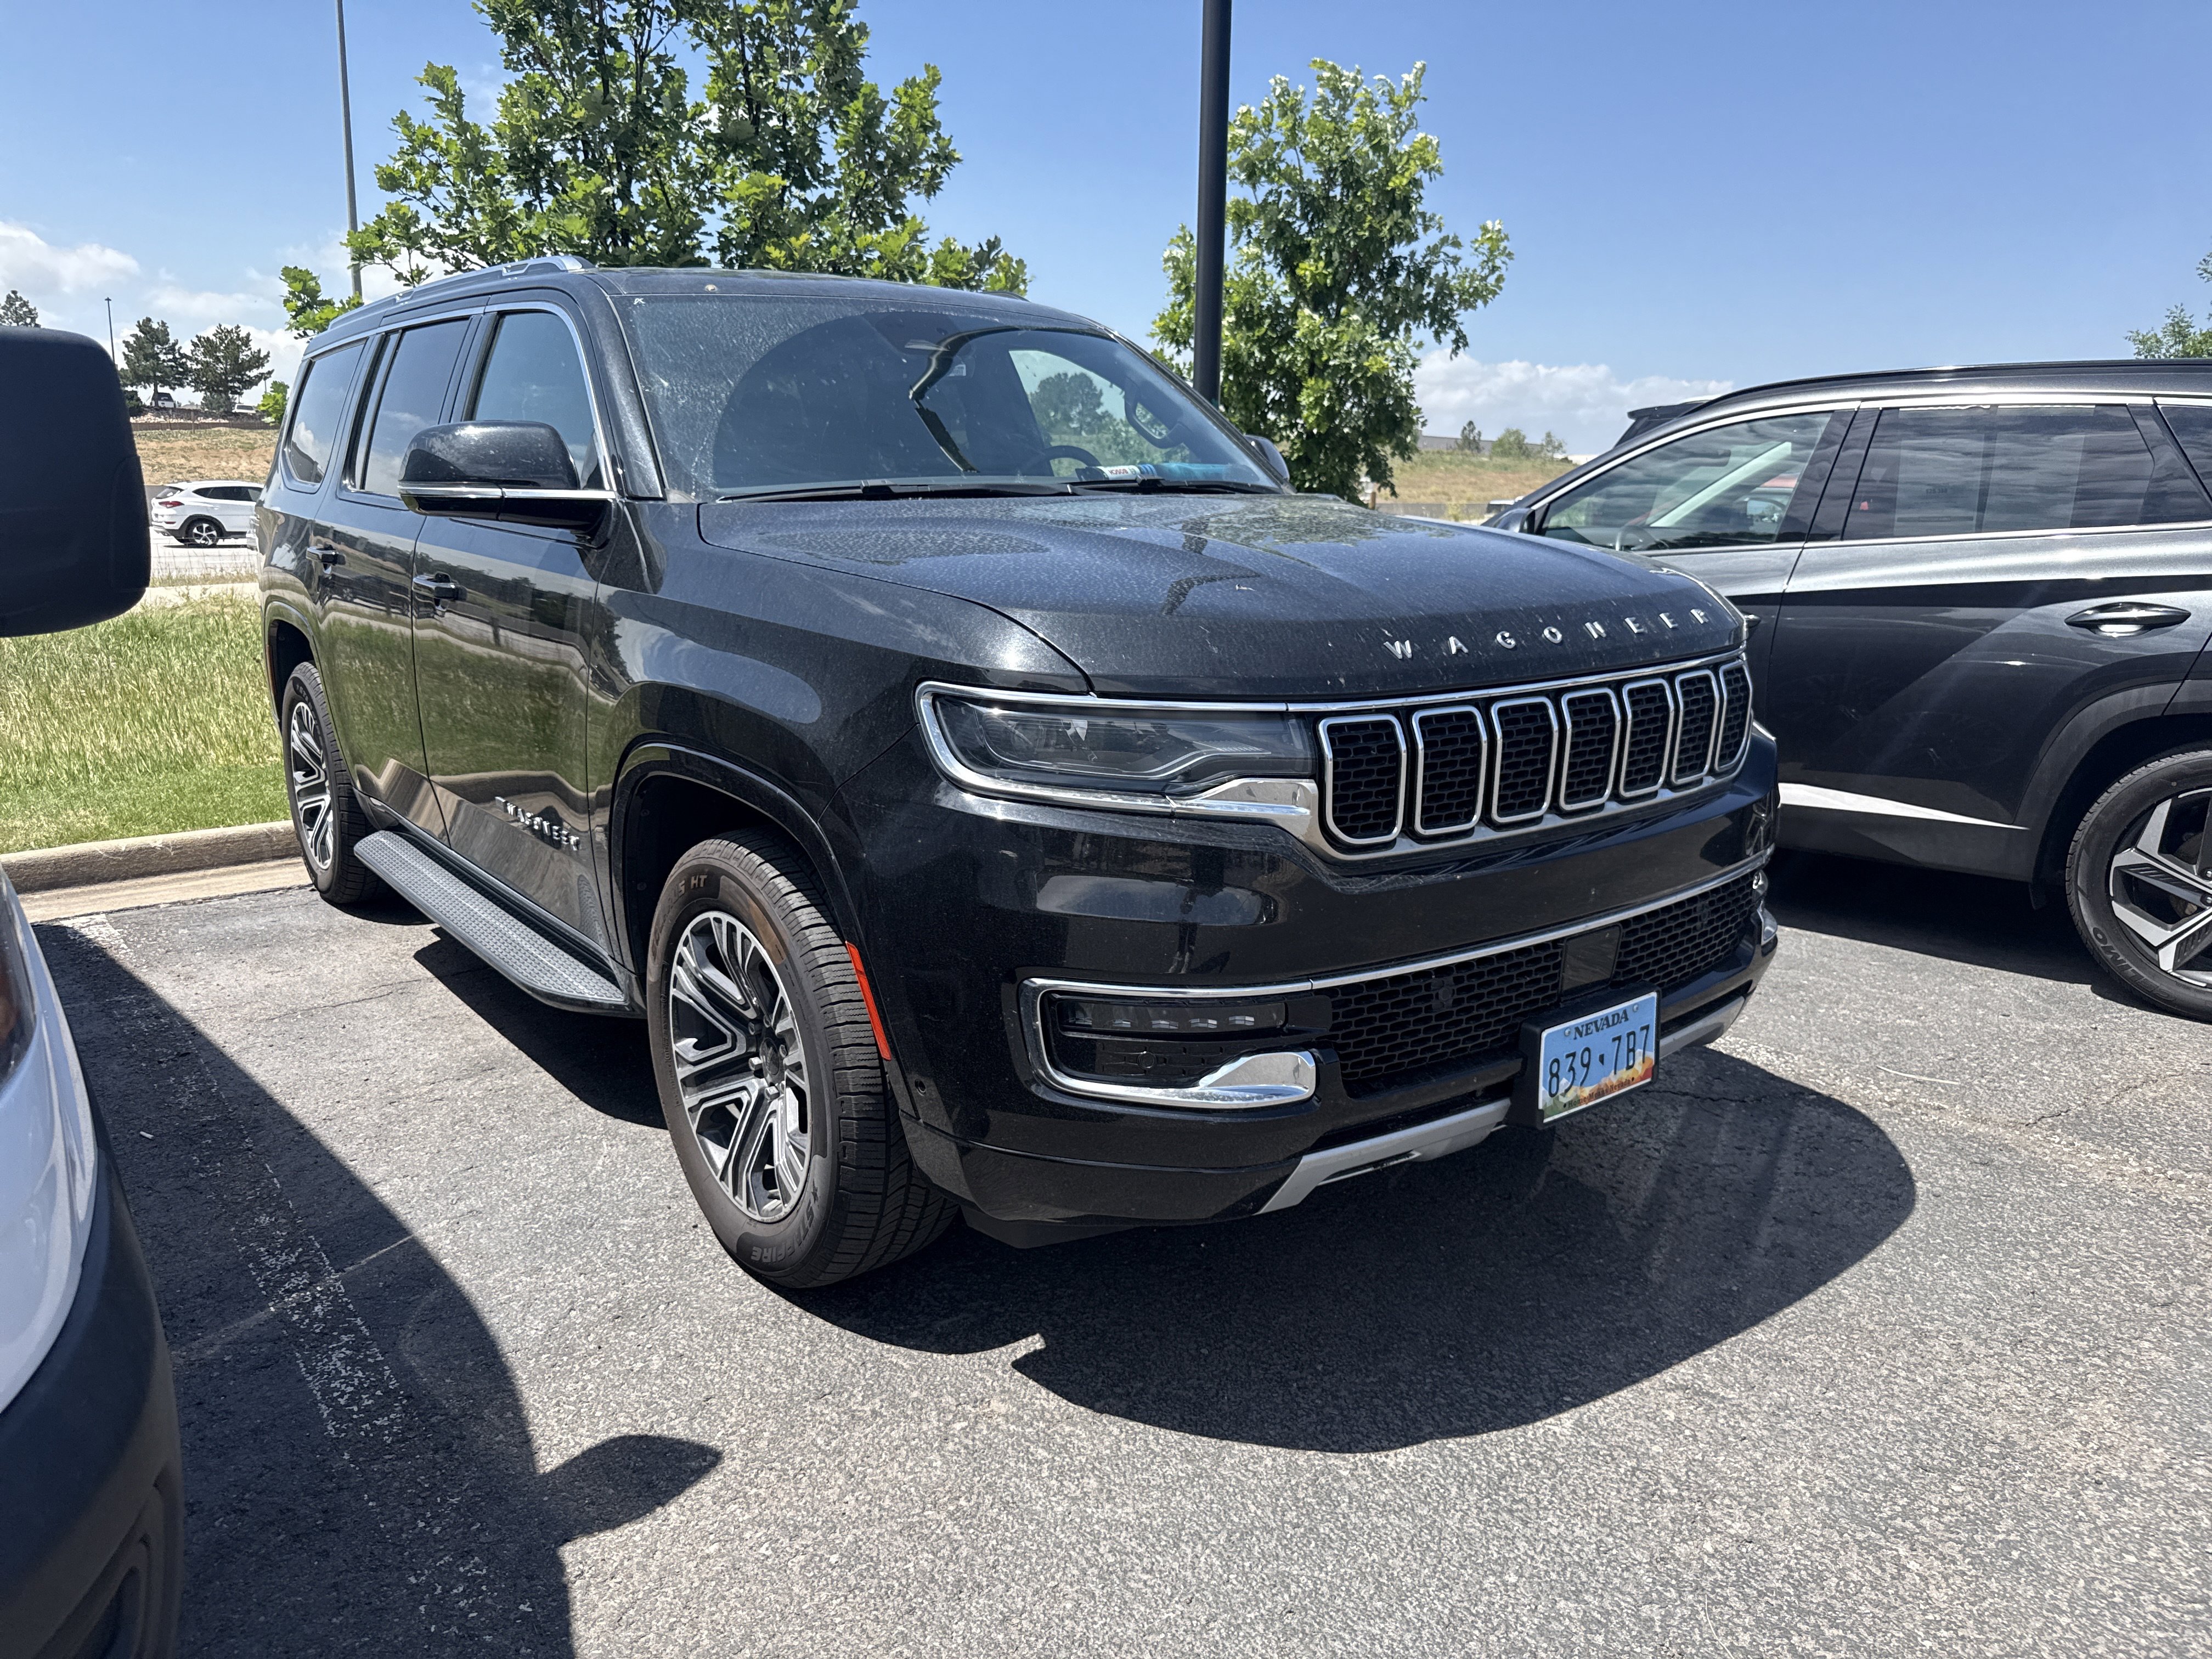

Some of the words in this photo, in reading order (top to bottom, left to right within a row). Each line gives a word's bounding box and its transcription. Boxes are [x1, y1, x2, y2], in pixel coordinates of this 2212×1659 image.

[1384, 608, 1709, 659] WAGONEER
[691, 874, 708, 889] HT
[1573, 1009, 1629, 1040] NEVADA
[1548, 1046, 1591, 1098] 839
[1612, 1024, 1650, 1075] 7B7
[1568, 1096, 1586, 1108] Home
[1589, 1087, 1608, 1101] Means
[1610, 1079, 1631, 1092] Nevada
[751, 1198, 815, 1262] STARFIRE
